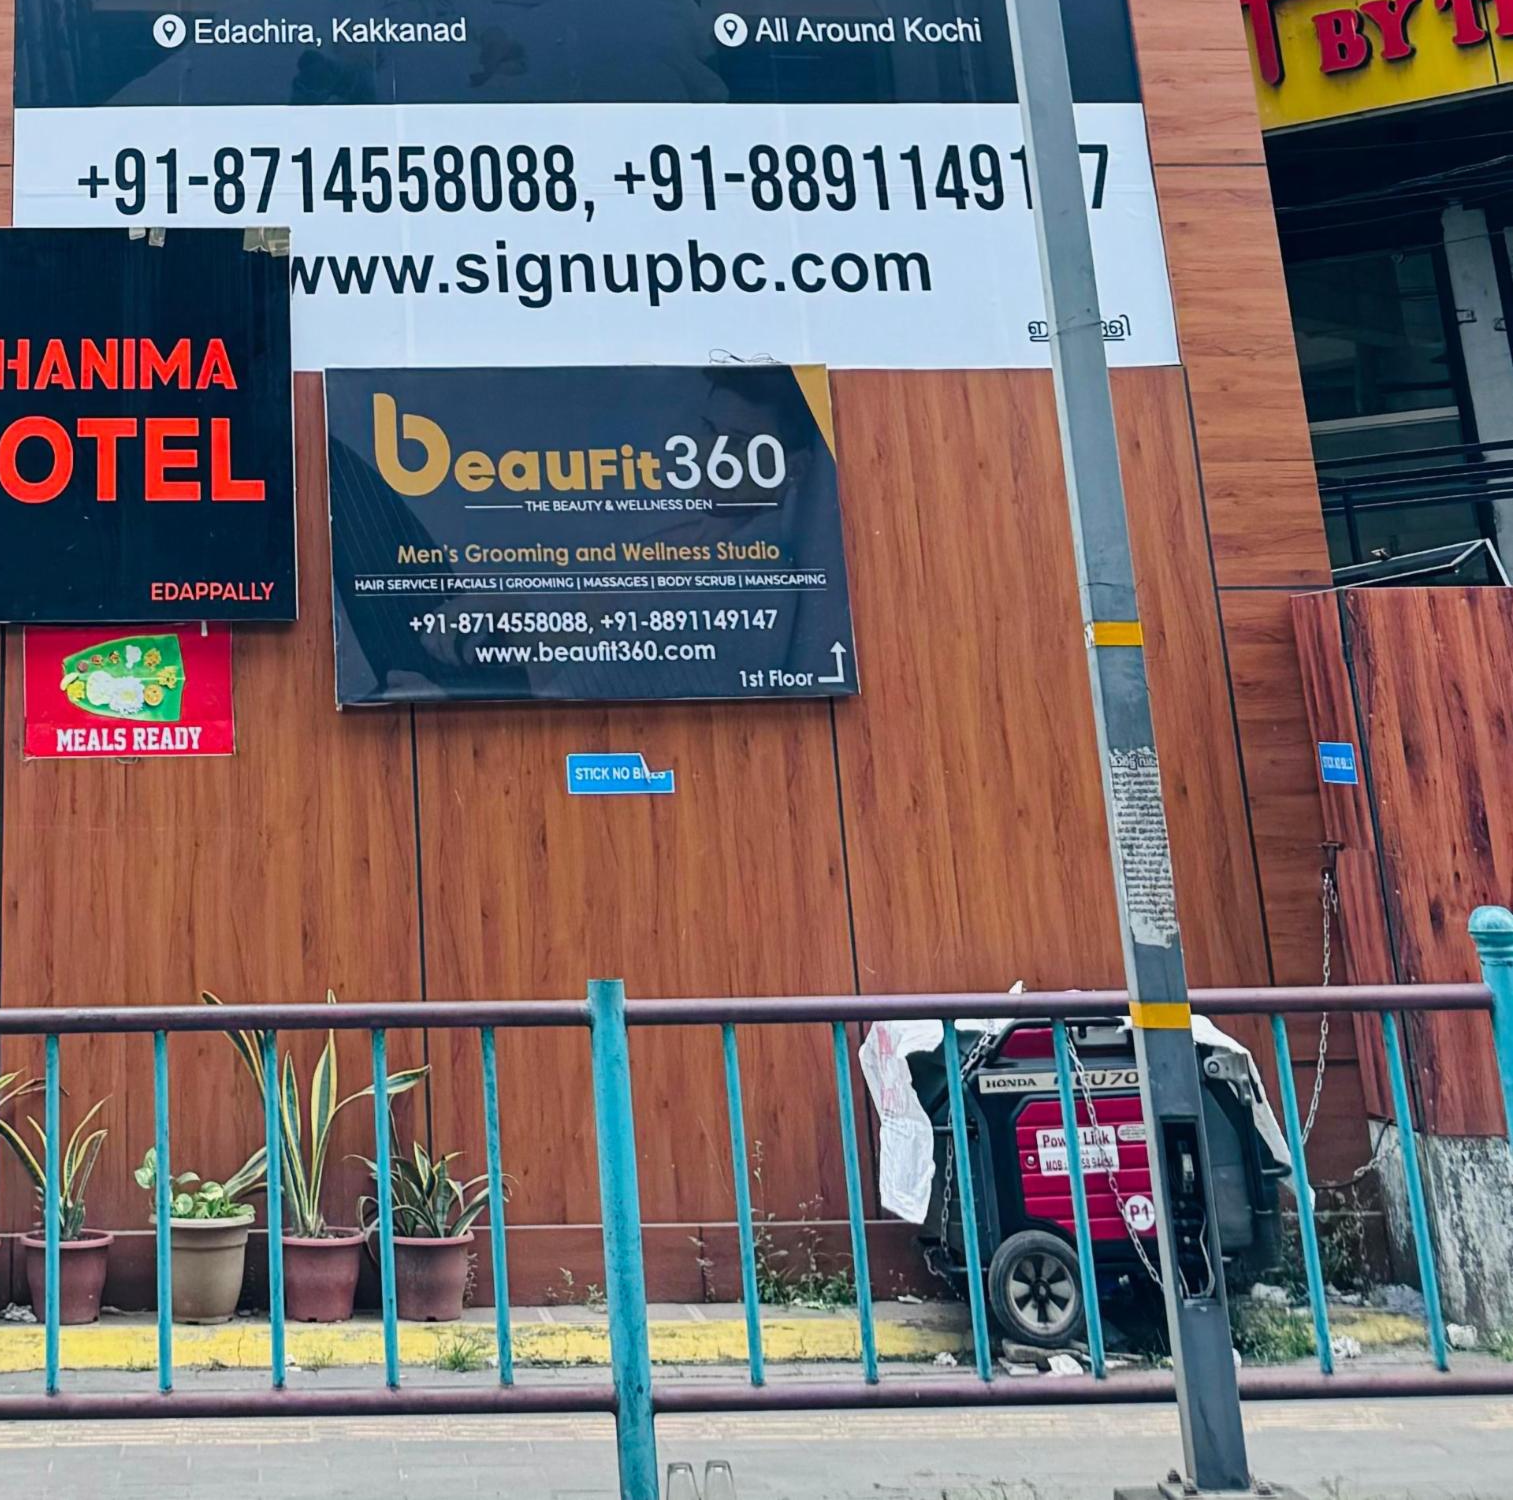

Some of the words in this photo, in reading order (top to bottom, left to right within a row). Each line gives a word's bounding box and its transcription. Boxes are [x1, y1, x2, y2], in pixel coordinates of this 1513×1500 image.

[195, 19, 323, 48] Edachira,
[332, 17, 467, 44] Kakkanad
[755, 17, 789, 42] All
[796, 17, 895, 42] Around
[905, 16, 982, 43] Kochi
[77, 144, 596, 222] +91-8714558088,
[613, 142, 1109, 212] +91-889114917
[291, 239, 933, 309] www.signupbc.com
[525, 500, 548, 511] THE
[552, 500, 602, 511] BEAUTY
[605, 500, 614, 511] &
[616, 499, 683, 510] WELLNESS
[686, 498, 713, 510] DEN
[150, 581, 274, 601] EDAPPALLY
[355, 579, 384, 591] HAIR
[387, 579, 438, 591] SERVICE
[447, 578, 496, 590] FACIALS
[506, 577, 574, 590] GROOMING
[584, 577, 648, 589] MASSAGES
[657, 576, 691, 588] BODY
[695, 576, 736, 588] SCRUB
[745, 574, 826, 587] MANSCAPING
[409, 611, 595, 636] +91-8714558088,
[600, 609, 778, 633] +91-8891149147
[475, 640, 717, 664] www.beaufit360.com
[739, 670, 764, 688] 1st
[769, 670, 814, 688] Floor
[55, 727, 127, 752] MEALS
[132, 725, 203, 751] READY
[575, 767, 609, 780] STICK
[613, 767, 630, 780] NO
[986, 1077, 1037, 1088] HONDA
[1129, 1204, 1150, 1222] P1
